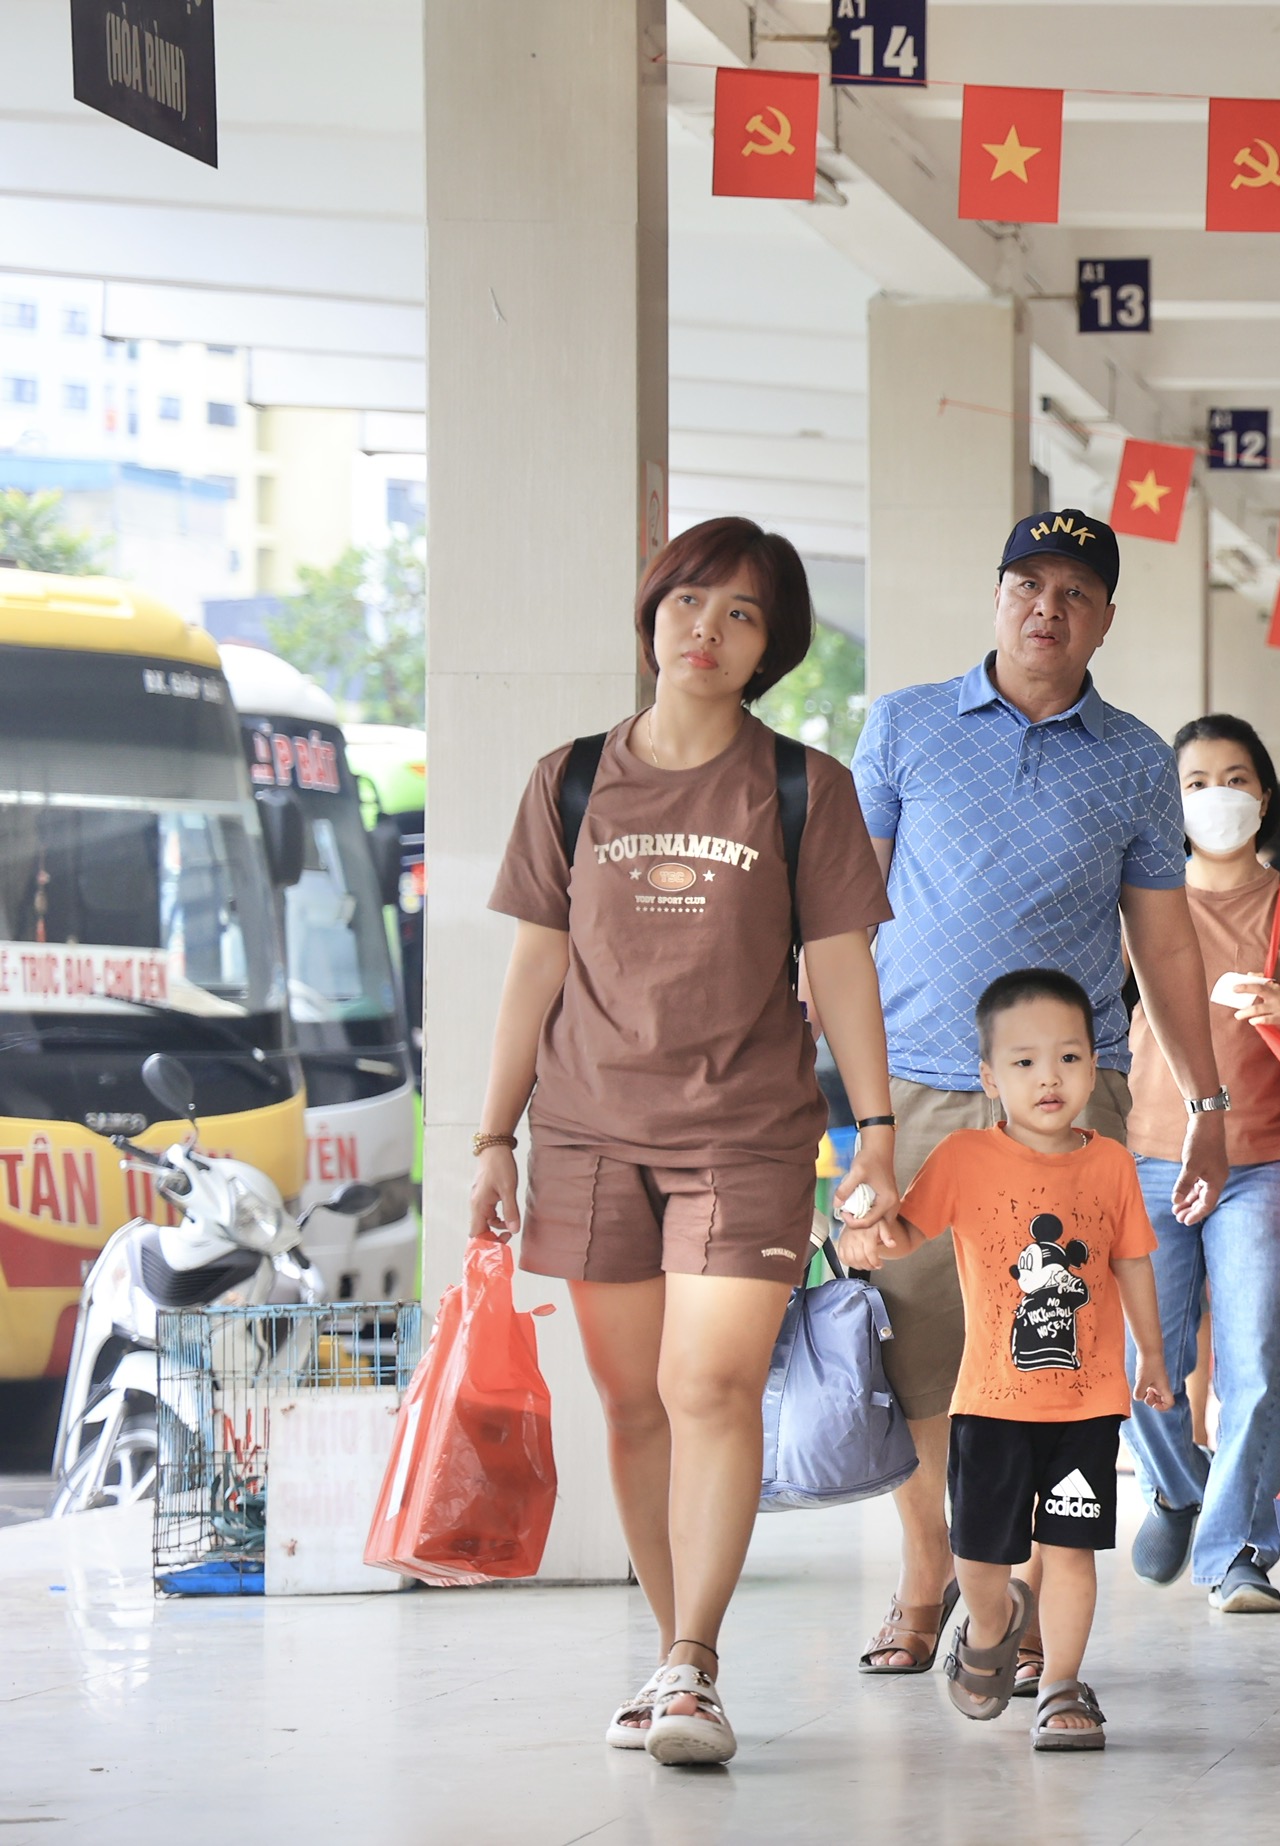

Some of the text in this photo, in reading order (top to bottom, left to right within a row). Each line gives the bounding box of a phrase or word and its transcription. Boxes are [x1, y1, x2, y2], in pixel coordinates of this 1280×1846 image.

[837, 0, 866, 18] A1
[106, 2, 187, 121] (HÒA BÌNH)
[850, 25, 918, 77] 14
[1080, 263, 1105, 282] A1
[1091, 284, 1145, 327] 13
[1218, 429, 1266, 467] 12
[1030, 516, 1096, 546] HNK
[594, 833, 759, 872] TOURNAMENT
[657, 896, 683, 905] SPORT
[684, 896, 706, 905] CLUB
[0, 1137, 98, 1226] TÂN
[1046, 1297, 1060, 1307] NO
[1044, 1496, 1101, 1518] adidas
